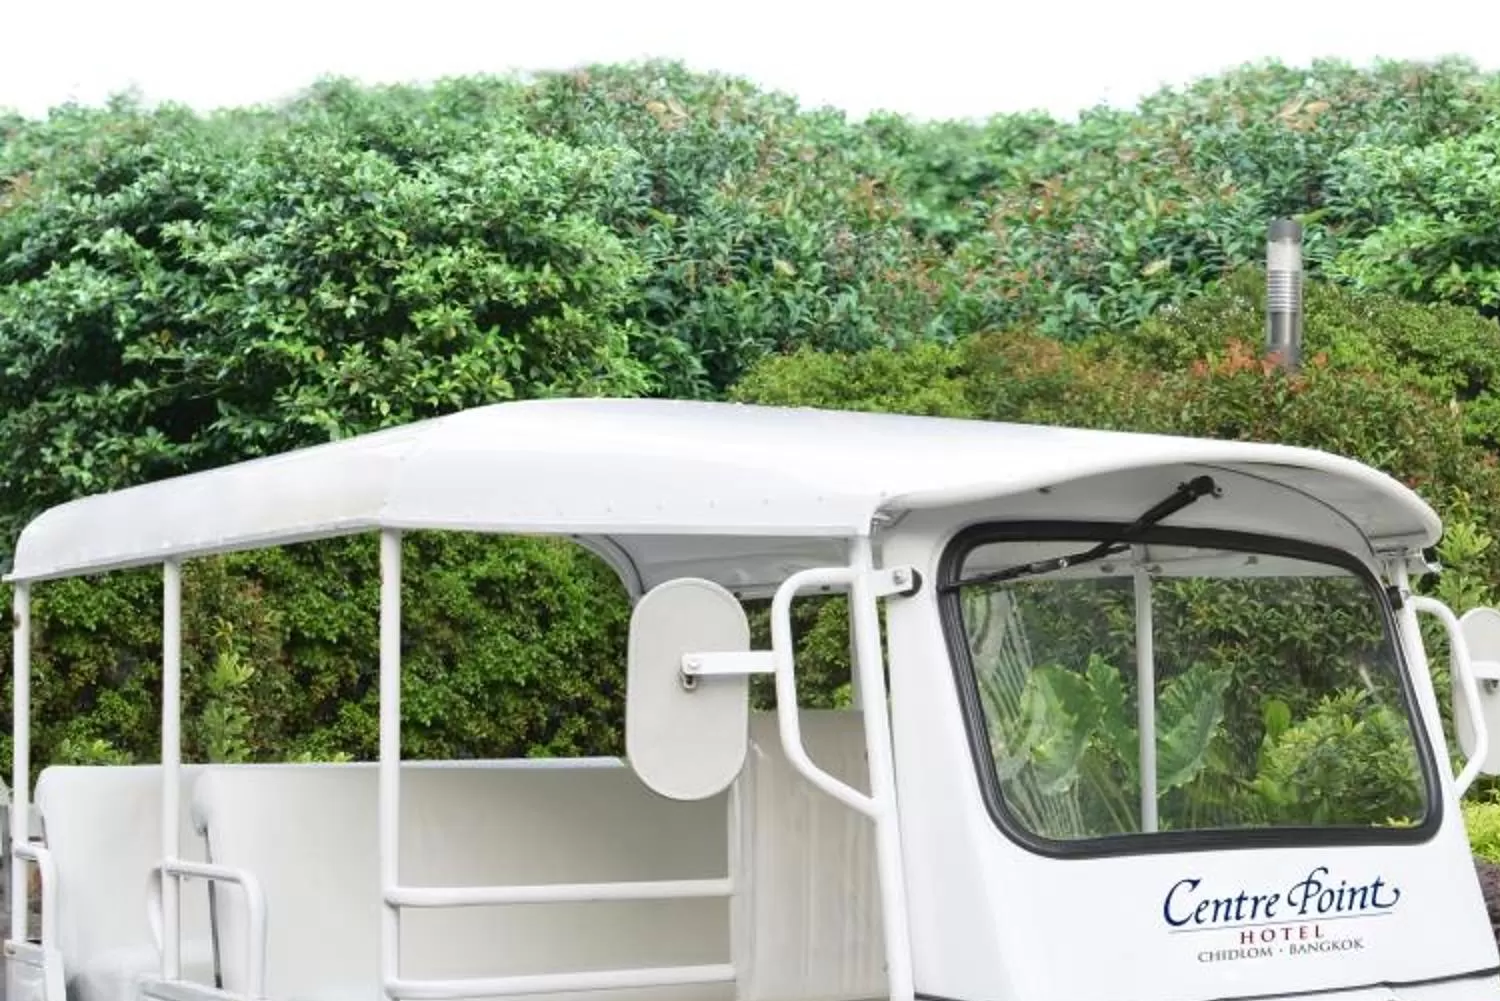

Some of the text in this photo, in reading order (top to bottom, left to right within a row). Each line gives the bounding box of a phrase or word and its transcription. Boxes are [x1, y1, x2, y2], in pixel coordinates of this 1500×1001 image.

[1162, 866, 1401, 927] Centre Point
[1239, 925, 1325, 945] HOTEL
[1197, 937, 1365, 963] CHIDLOM BANGKOK
